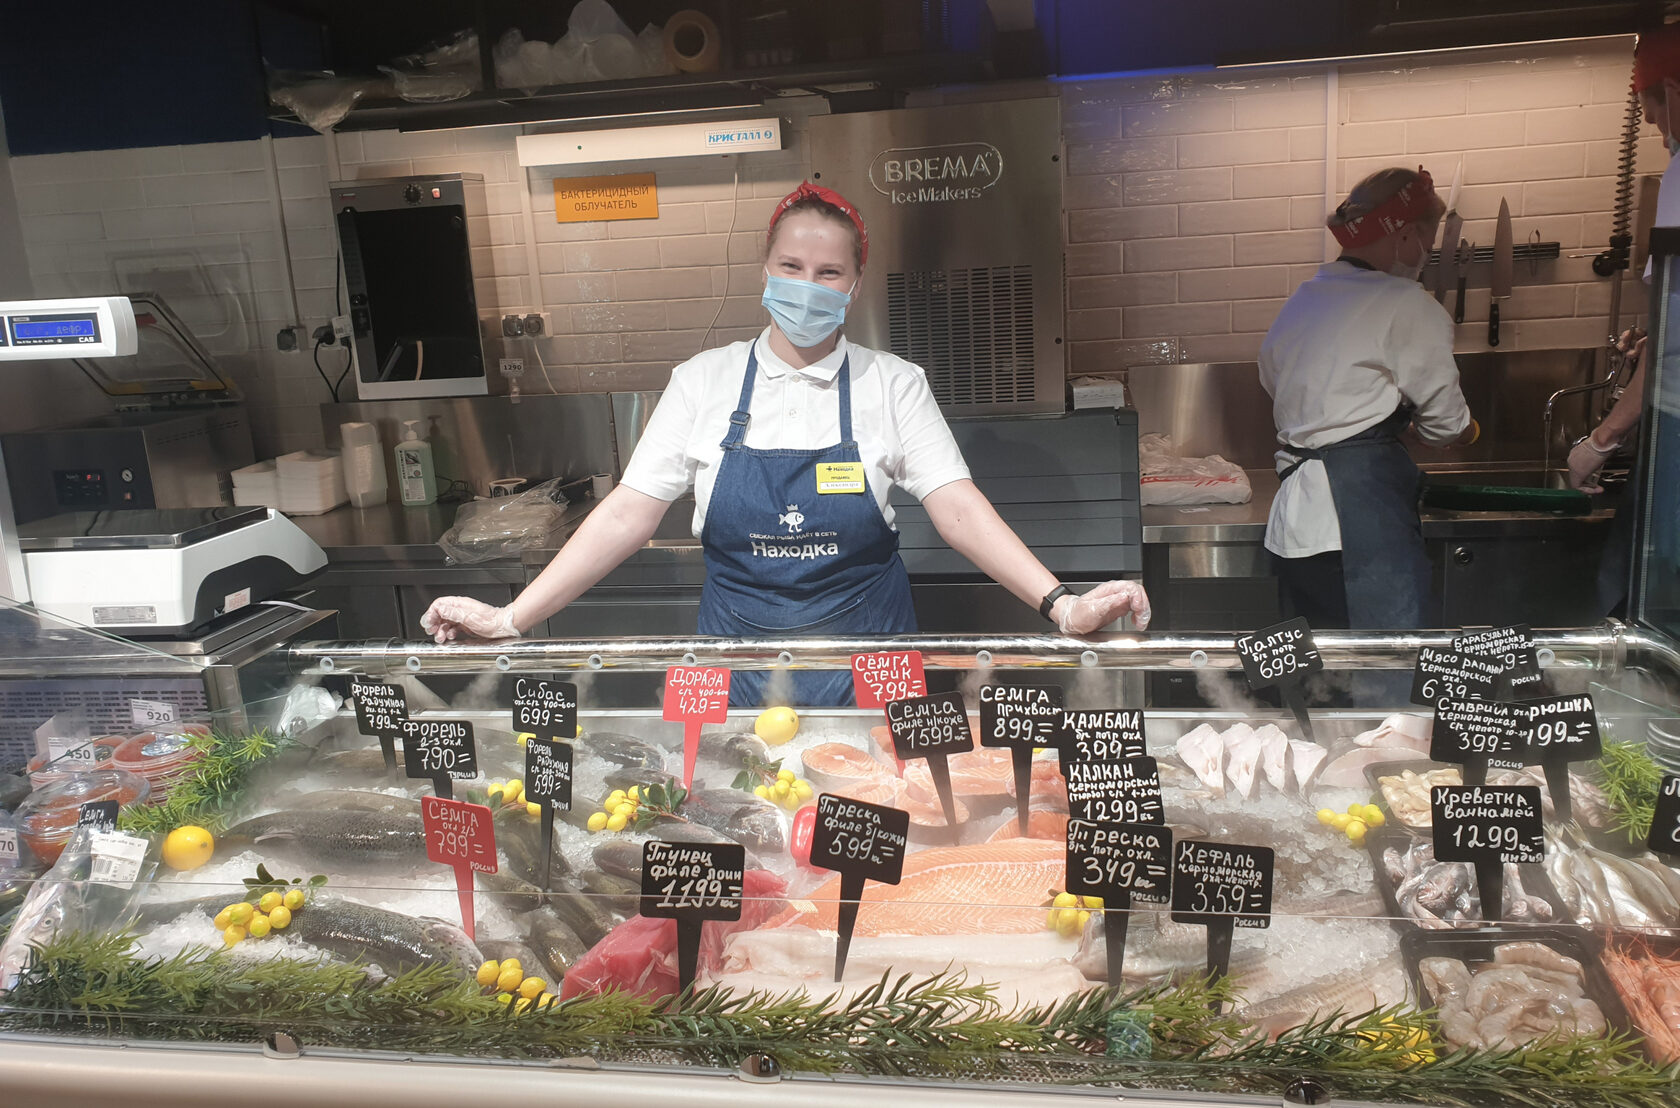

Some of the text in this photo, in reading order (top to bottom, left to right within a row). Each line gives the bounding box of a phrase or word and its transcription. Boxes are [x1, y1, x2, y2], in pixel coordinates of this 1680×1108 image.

[708, 131, 760, 143] КРИСТАЛЛ
[884, 154, 991, 183] BREMA
[561, 184, 649, 200] БАКТЕРИЦИДНЫЙ
[574, 200, 638, 212] ОБЛУЧАТЕЛЬ
[751, 541, 839, 561] Находка
[669, 668, 723, 687] ДОРАДА
[351, 683, 394, 697] ФОРЕЛЬ
[516, 678, 565, 701] Сибас
[981, 686, 1050, 703] СЕМГА
[146, 711, 170, 722] 920
[1529, 697, 1593, 722] РЮШКА
[1062, 711, 1140, 730] КАМБАЛА
[403, 722, 466, 739] ФОРЕЛЬ
[65, 748, 91, 760] 450
[1069, 763, 1134, 782] КАЛКАН
[1435, 786, 1528, 808] Креветка
[819, 795, 881, 824] Треска
[1068, 819, 1160, 848] Треска
[0, 840, 14, 852] 70
[646, 841, 713, 867] Тунец
[1179, 842, 1255, 868] КЕФАЛЬ
[650, 864, 701, 881] филе
